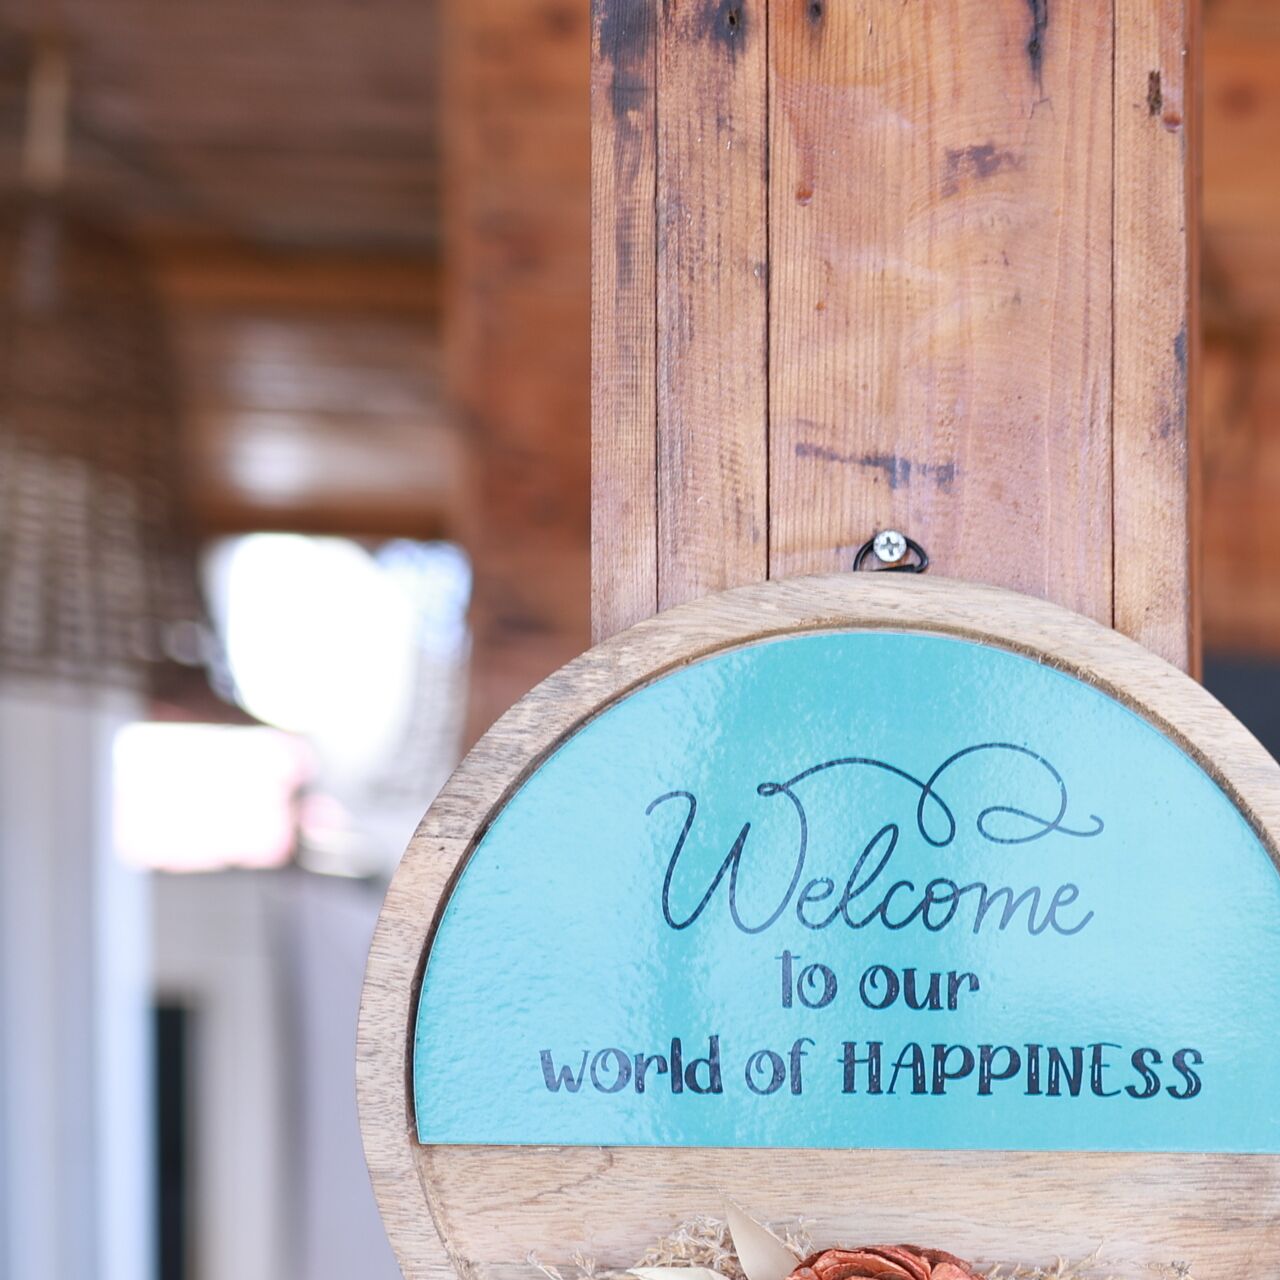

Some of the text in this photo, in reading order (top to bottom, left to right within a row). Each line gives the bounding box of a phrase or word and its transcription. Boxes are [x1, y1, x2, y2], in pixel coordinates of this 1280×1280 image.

[645, 742, 1104, 936] Welcome
[774, 949, 981, 1012] to our
[538, 1034, 1205, 1100] world of HAPPINESS
